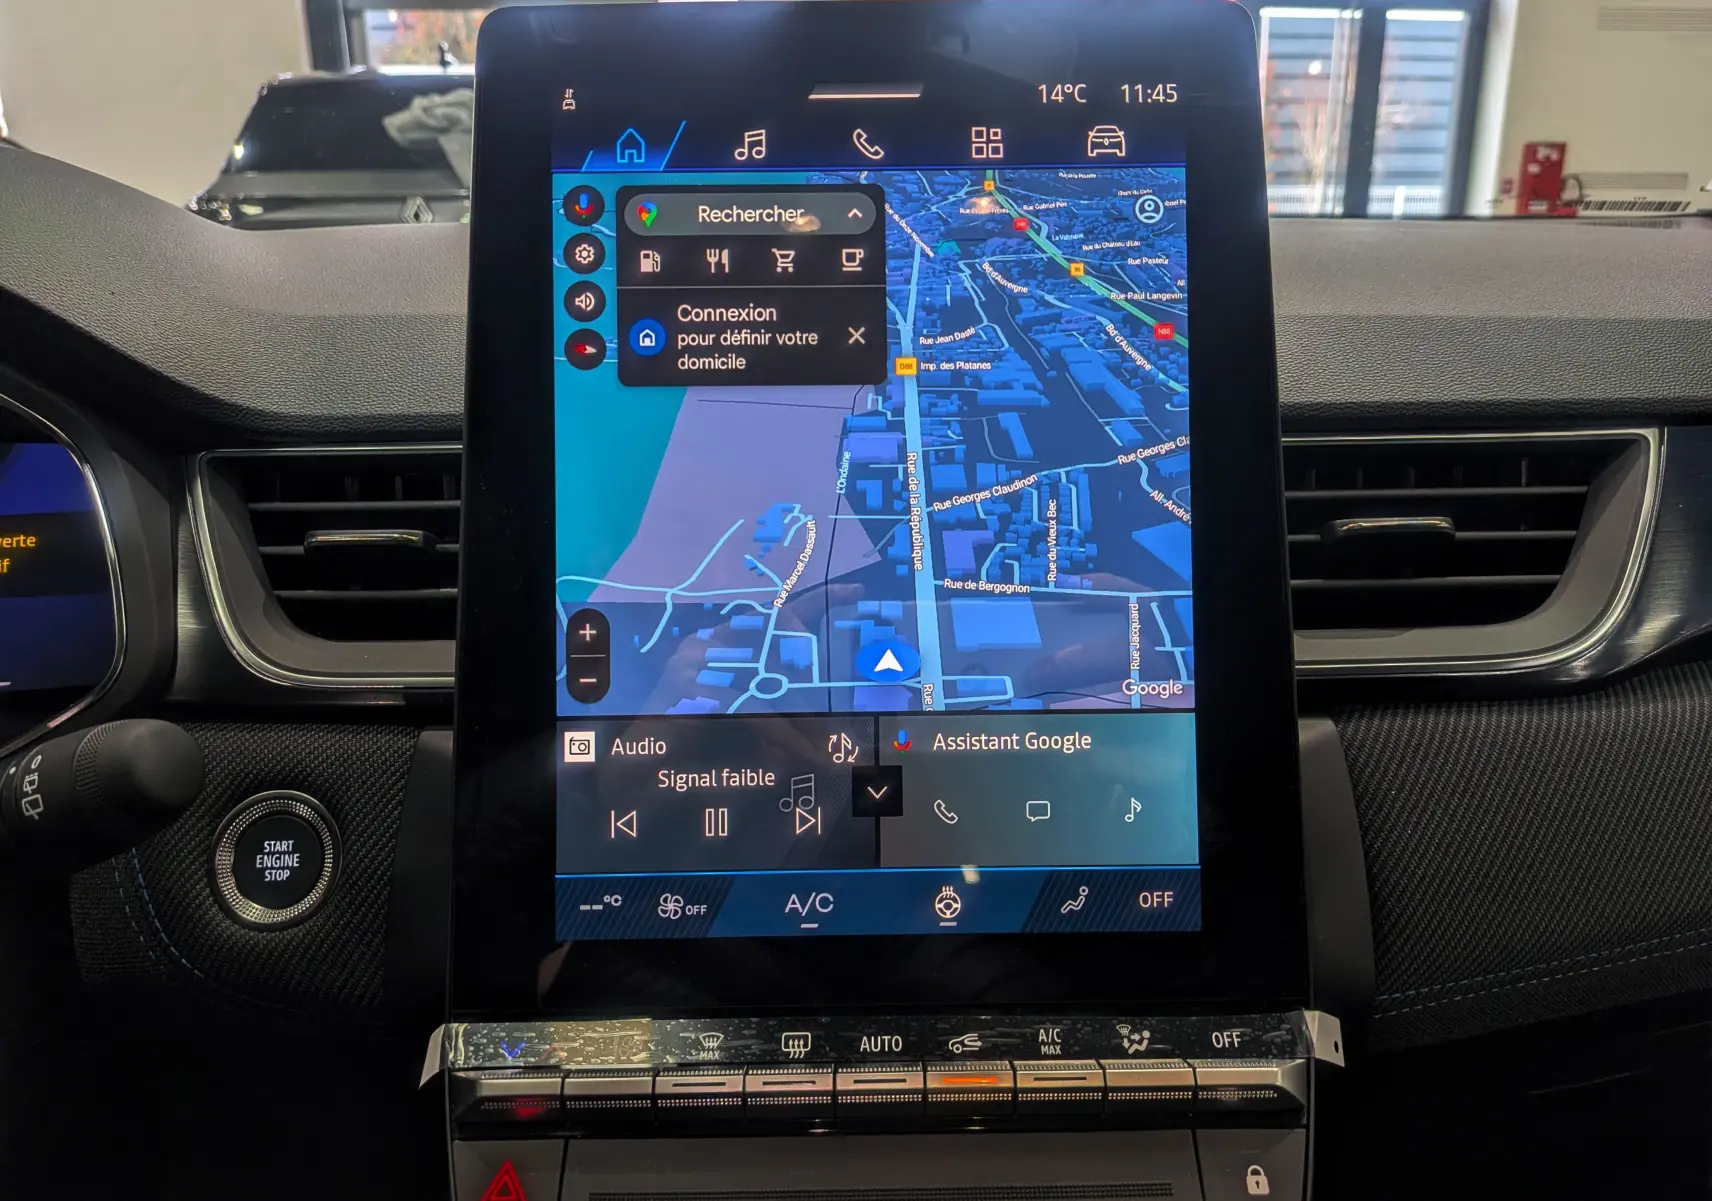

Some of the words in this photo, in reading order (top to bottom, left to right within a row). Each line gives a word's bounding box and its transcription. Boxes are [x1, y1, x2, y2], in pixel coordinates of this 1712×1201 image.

[1038, 84, 1087, 103] 14°C
[1120, 84, 1178, 103] 11:45
[698, 205, 804, 223] Rechercher
[1128, 258, 1141, 266] Rue
[1142, 257, 1169, 265] Pasteur
[982, 261, 992, 275] Bd
[991, 268, 1029, 294] d'Auvergne
[1110, 292, 1125, 300] Rue
[1128, 292, 1145, 300] Paul
[1147, 292, 1183, 302] Langevin
[677, 303, 777, 322] Connexion
[677, 333, 716, 350] pour
[720, 329, 772, 346] définir
[776, 332, 819, 346] votre
[920, 336, 934, 346] Rue
[934, 334, 954, 344] Jean
[954, 326, 976, 341] Dasté
[1106, 323, 1117, 338] Bd
[1114, 334, 1152, 372] d'Auvergne
[677, 353, 746, 370] domicile
[920, 362, 938, 372] Imp.
[940, 361, 954, 370] des
[956, 361, 992, 370] Platanes
[1117, 452, 1136, 465] Rue
[1136, 441, 1176, 459] Georges
[836, 451, 852, 494] L'Ondaine
[906, 452, 918, 474] Rue
[908, 478, 920, 492] de
[932, 500, 952, 512] Rue
[952, 490, 992, 506] Georges
[992, 474, 1038, 497] Claudinon
[910, 495, 919, 506] la
[1047, 498, 1057, 518] Bec
[0, 534, 36, 548] erte
[910, 506, 924, 572] République
[1047, 520, 1057, 546] Vieux
[774, 589, 790, 608] Rue
[782, 562, 805, 591] Marcel
[800, 520, 816, 566] Dassault
[1047, 548, 1057, 562] du
[1047, 562, 1057, 582] Rue
[944, 578, 963, 589] Rue
[964, 580, 977, 590] de
[978, 580, 1030, 594] Bergognon
[1128, 603, 1142, 649] Jacquard
[1130, 650, 1140, 670] Rue
[924, 684, 934, 705] Rue
[1122, 678, 1183, 698] Google
[611, 738, 666, 756] Audio
[933, 732, 1020, 751] Assistant
[1024, 732, 1092, 754] Google
[658, 769, 717, 792] Signal
[721, 768, 776, 787] faible
[263, 840, 294, 852] START
[256, 853, 300, 868] ENGINE
[264, 869, 290, 882] STOP
[784, 892, 834, 916] A/C
[1138, 892, 1174, 908] OFF
[685, 904, 708, 916] OFF
[860, 1036, 902, 1052] AUTO
[1038, 1028, 1061, 1042] A/C
[1211, 1032, 1242, 1048] OFF
[700, 1049, 720, 1060] MAX
[1040, 1044, 1062, 1056] MAX
